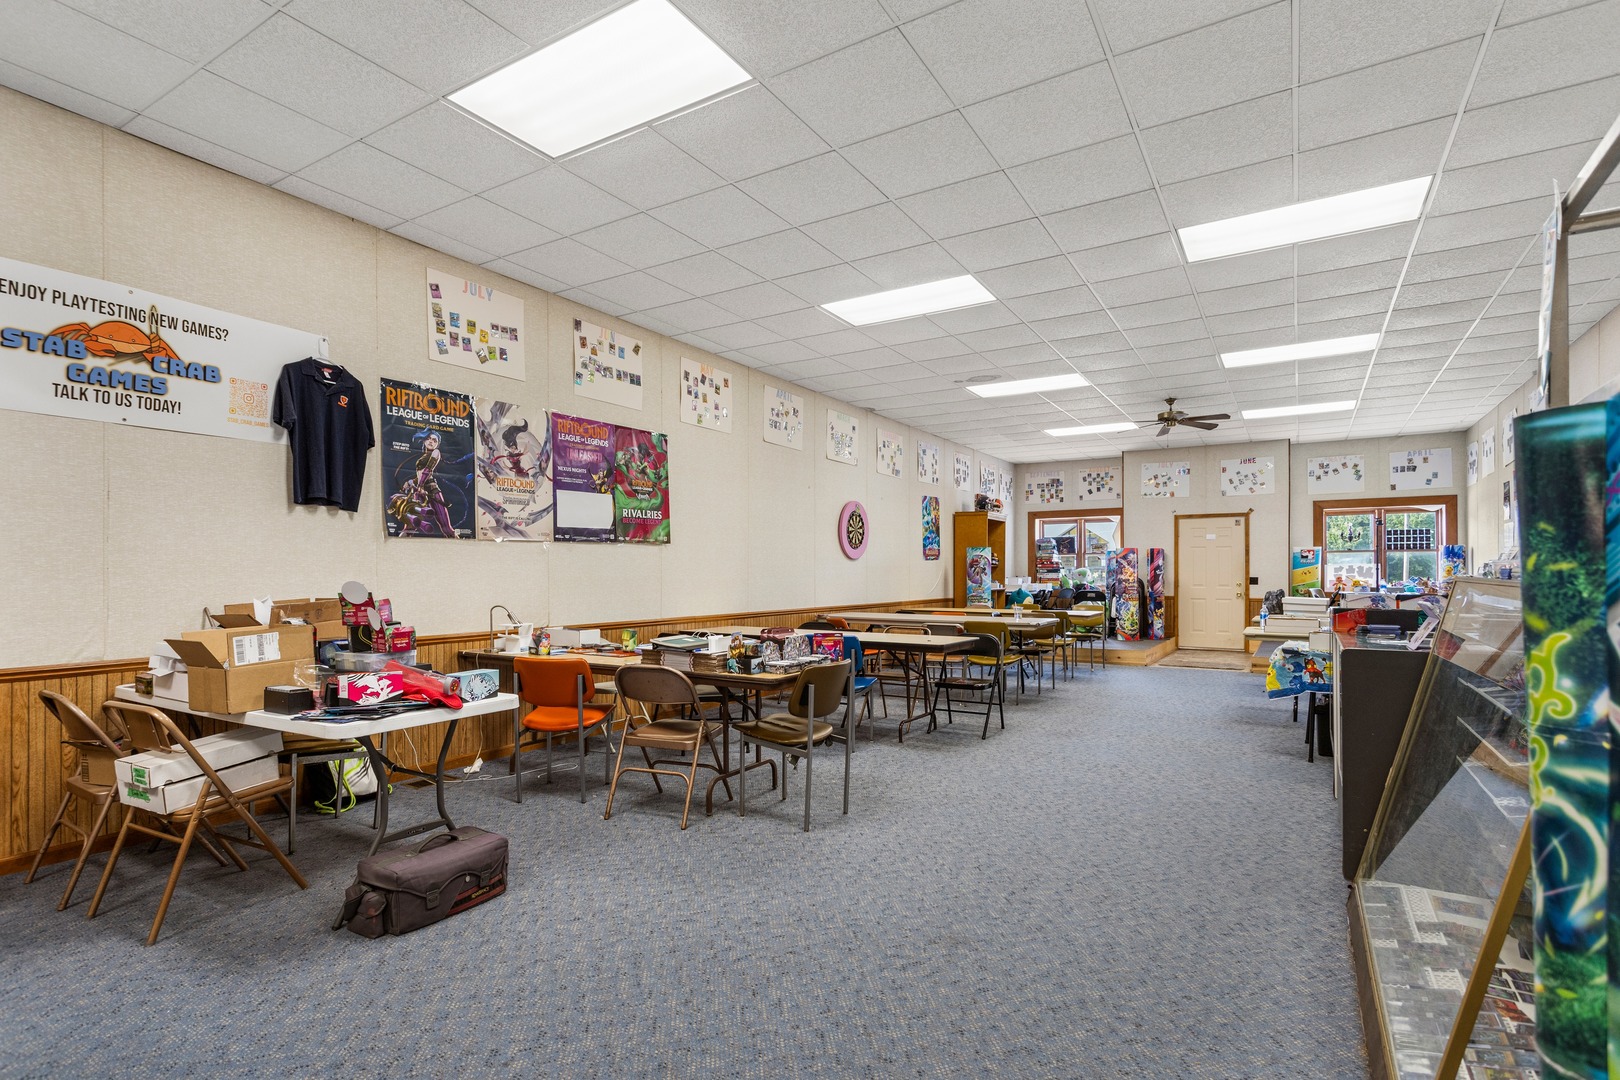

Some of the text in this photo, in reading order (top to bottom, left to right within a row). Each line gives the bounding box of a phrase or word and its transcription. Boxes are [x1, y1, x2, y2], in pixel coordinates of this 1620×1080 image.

[462, 280, 494, 302] JULY
[0, 278, 229, 342] ENJOY PLAYTESTING NEW GAMES?
[1, 327, 89, 359] STAB
[66, 363, 168, 396] GAMES
[151, 355, 222, 383] CRAB
[52, 383, 182, 415] TALK TO US TODAY!
[385, 386, 470, 418] RIFTBOUND
[386, 405, 423, 421] LEAGUE
[429, 413, 470, 428] LEGENDS
[405, 420, 425, 428] TRADING
[557, 418, 609, 440] RIFTBOUND
[558, 432, 581, 443] LEAGUE
[584, 437, 609, 448] LEGENDS
[1240, 457, 1257, 465] JUNE
[1407, 449, 1435, 458] APRIL
[496, 477, 535, 489] RIFTBOUND
[622, 508, 663, 520] RIVALRIES
[622, 517, 645, 525] BECOME
